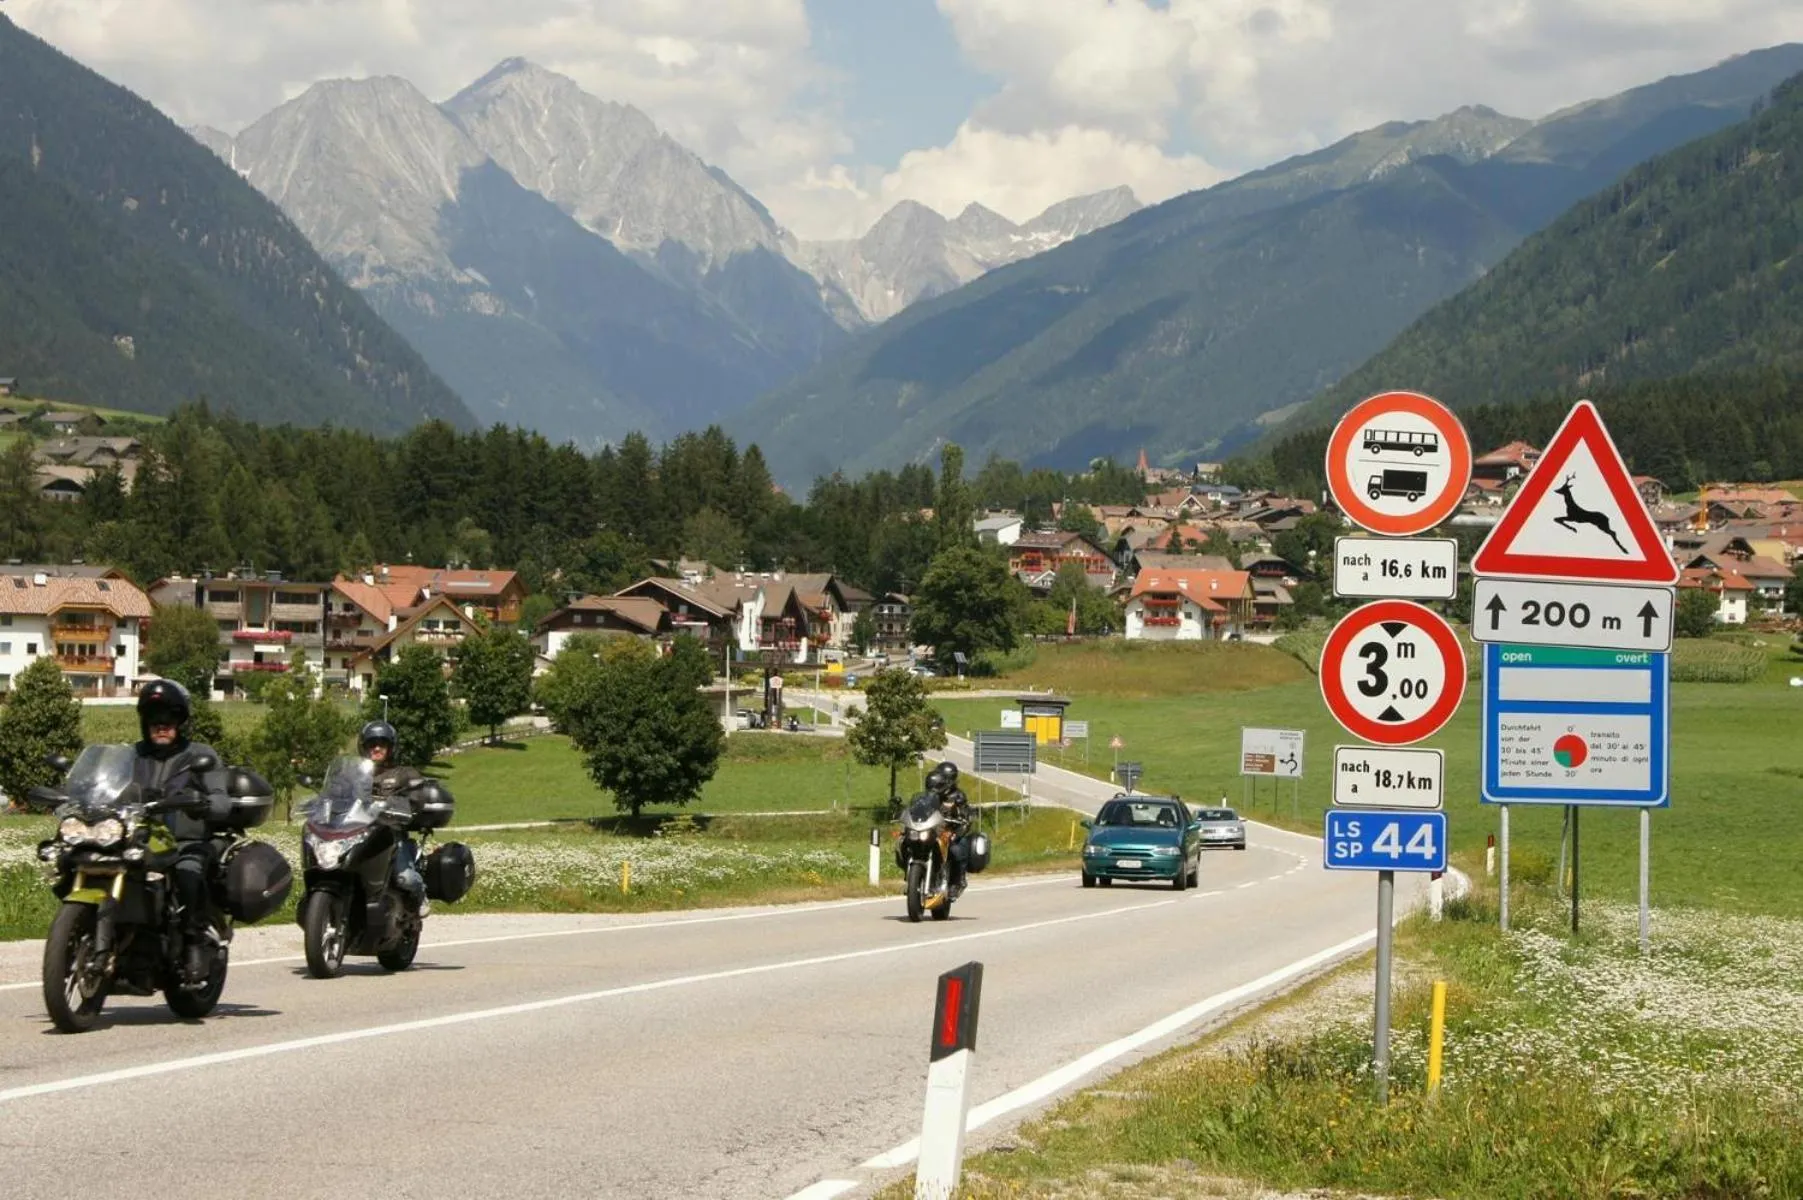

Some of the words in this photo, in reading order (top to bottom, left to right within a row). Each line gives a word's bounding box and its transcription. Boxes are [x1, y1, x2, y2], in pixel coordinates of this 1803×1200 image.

[1343, 553, 1371, 566] nach
[1380, 559, 1412, 578] 16.6
[1421, 560, 1447, 579] km
[1362, 571, 1369, 581] a
[1521, 600, 1591, 629] 200
[1602, 616, 1621, 630] m
[1397, 642, 1415, 659] m
[1502, 651, 1532, 663] open
[1615, 652, 1649, 664] overt
[1501, 723, 1542, 732] Durchfahrt
[1341, 760, 1370, 773] nach
[1351, 783, 1358, 794] a
[1333, 820, 1361, 838] LS
[1371, 822, 1437, 860] 44
[1334, 841, 1363, 859] SP
